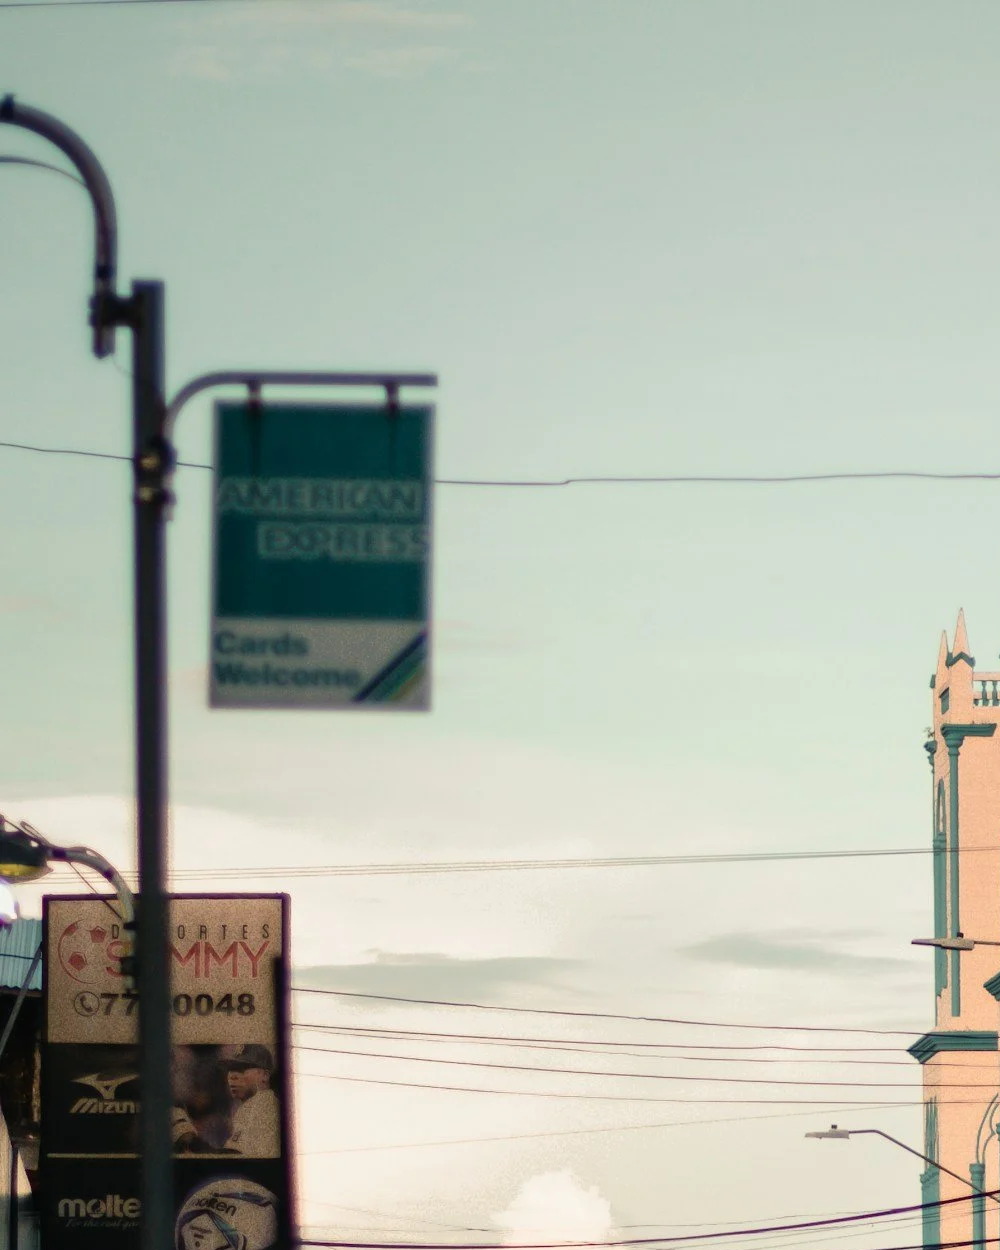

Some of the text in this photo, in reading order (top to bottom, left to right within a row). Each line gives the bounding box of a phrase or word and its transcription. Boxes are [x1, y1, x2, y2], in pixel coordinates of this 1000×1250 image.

[217, 477, 425, 514] AMERICAN
[258, 521, 428, 561] EXPRESS
[216, 632, 309, 658] Cards
[215, 662, 361, 688] Welcome
[104, 940, 270, 979] SMMY
[57, 1194, 141, 1219] molte
